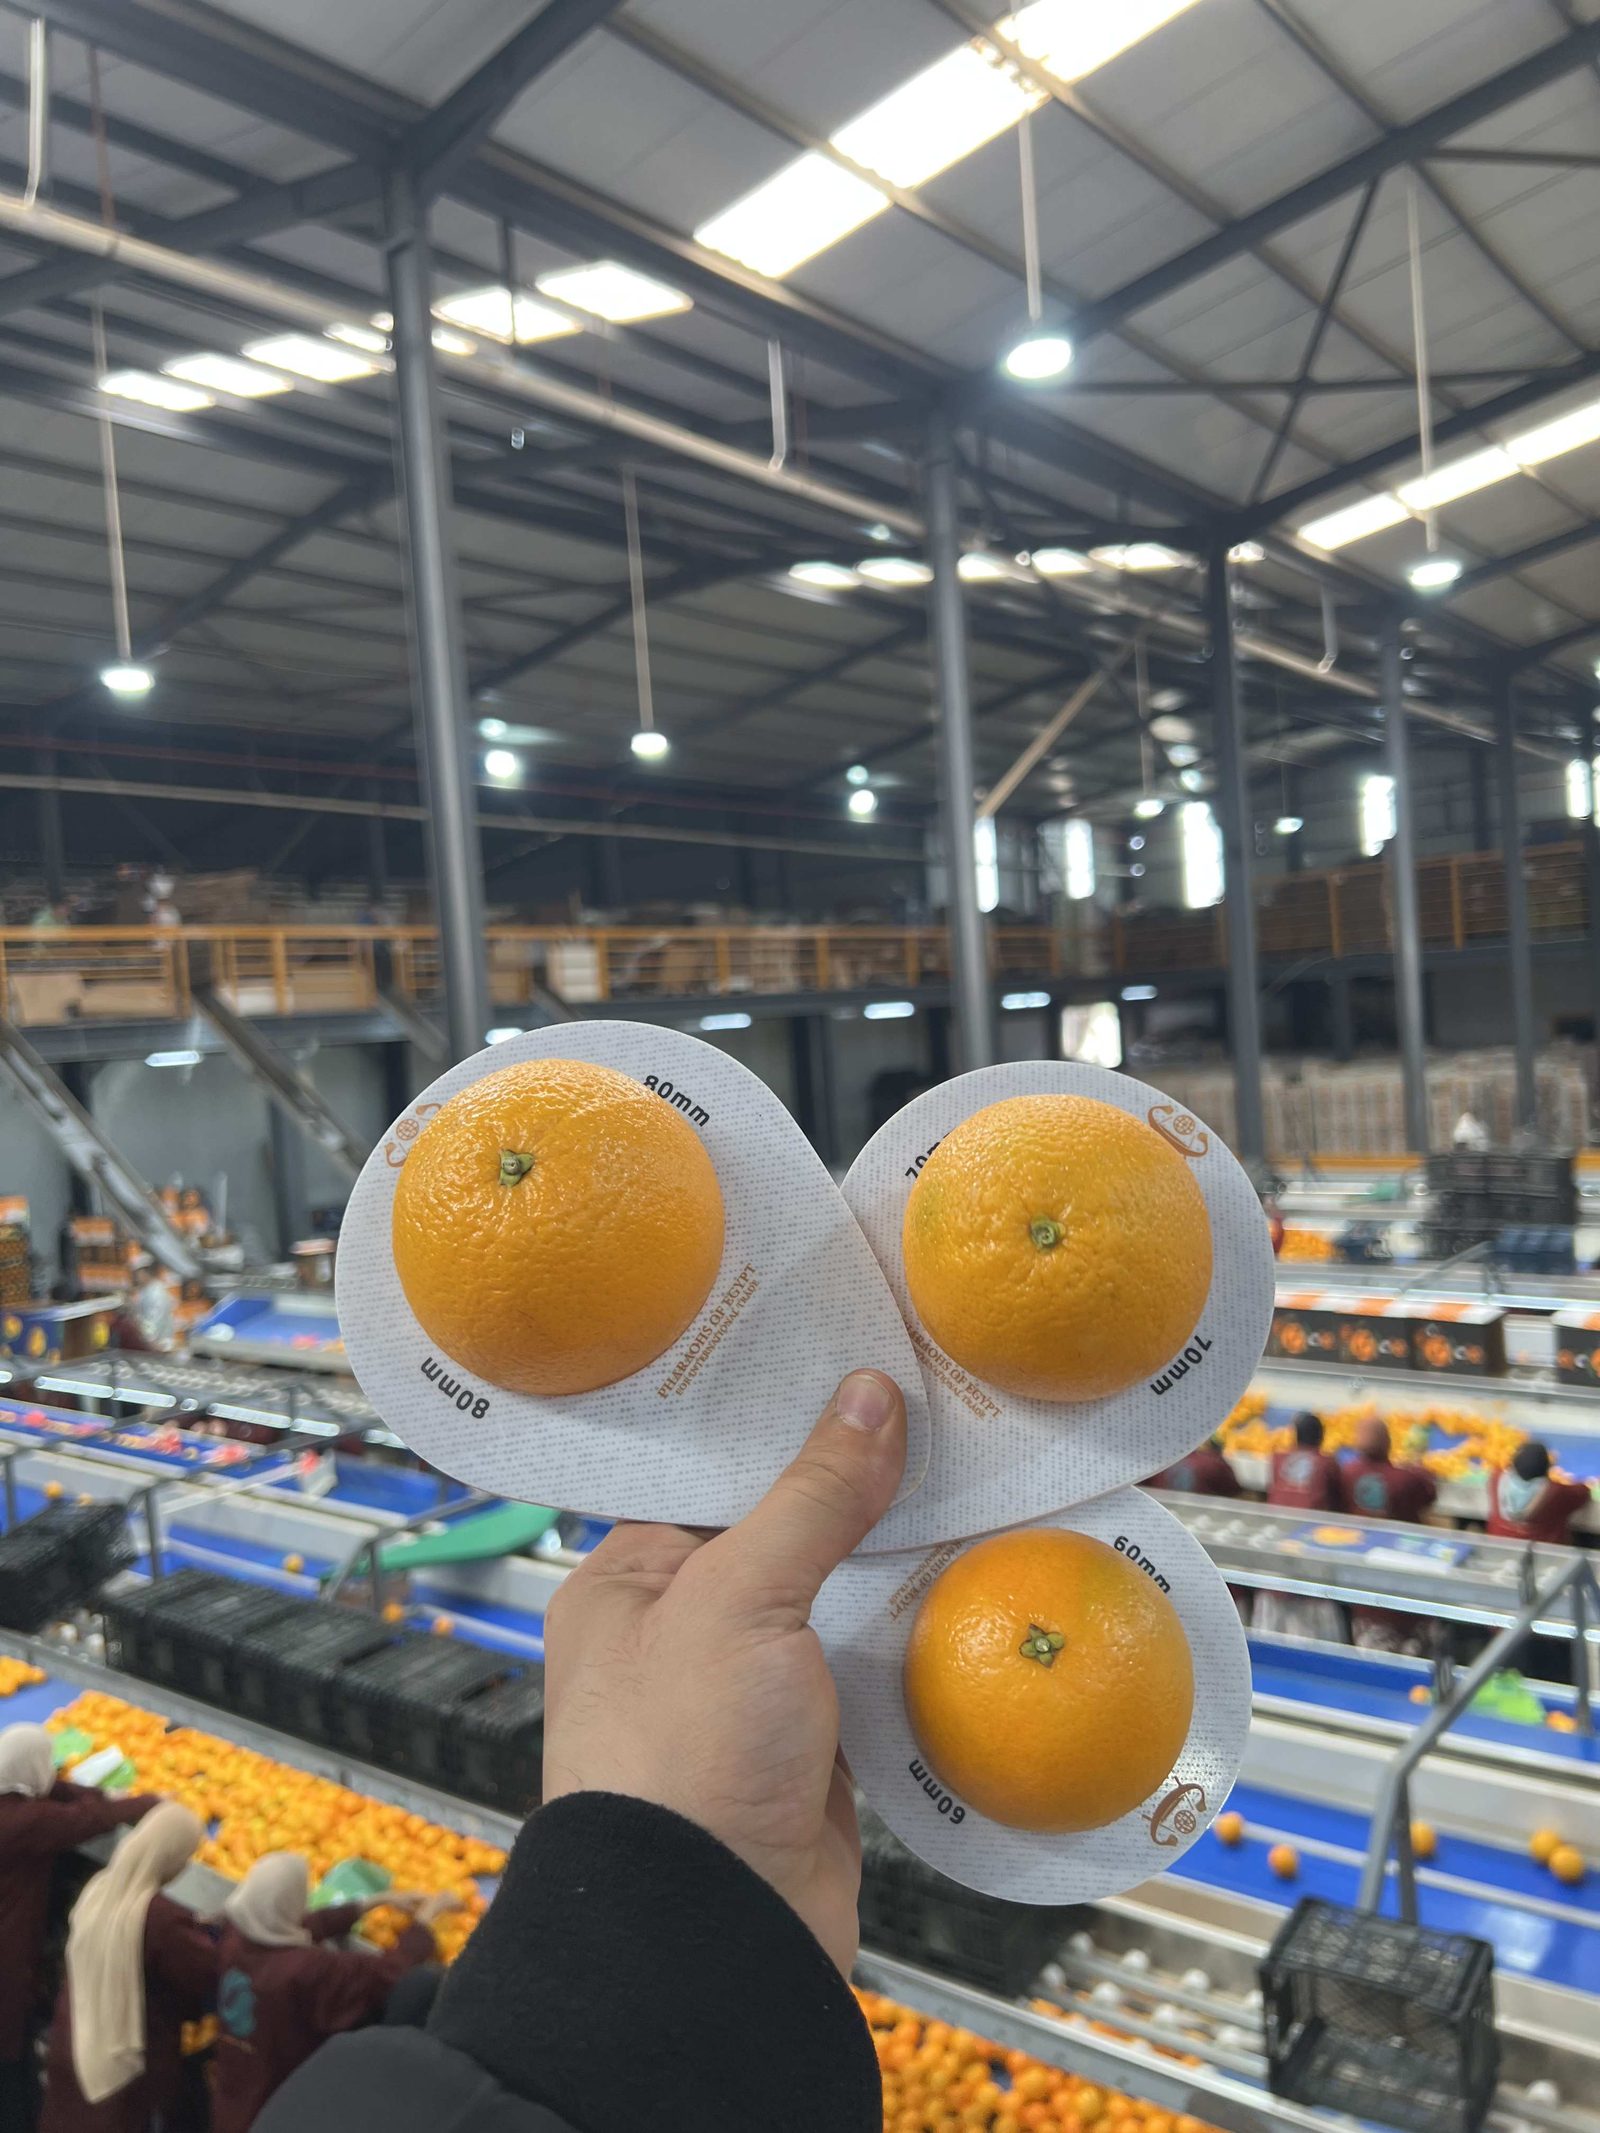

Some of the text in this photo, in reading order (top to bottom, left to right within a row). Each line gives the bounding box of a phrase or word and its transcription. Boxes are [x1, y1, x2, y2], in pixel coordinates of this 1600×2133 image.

[643, 1075, 710, 1127] 80mm
[657, 1263, 756, 1400] PHARAOHS OF EGYPT
[675, 1280, 759, 1396] FOR INTERNATIONAL TRADE
[421, 1357, 490, 1419] 80mm
[950, 1369, 968, 1384] OF
[966, 1382, 1003, 1418] EGYPT
[1150, 1335, 1212, 1395] 70mm
[1113, 1536, 1170, 1594] 60mm
[890, 1587, 918, 1621] EGYPT
[909, 1759, 965, 1825] 60mm
